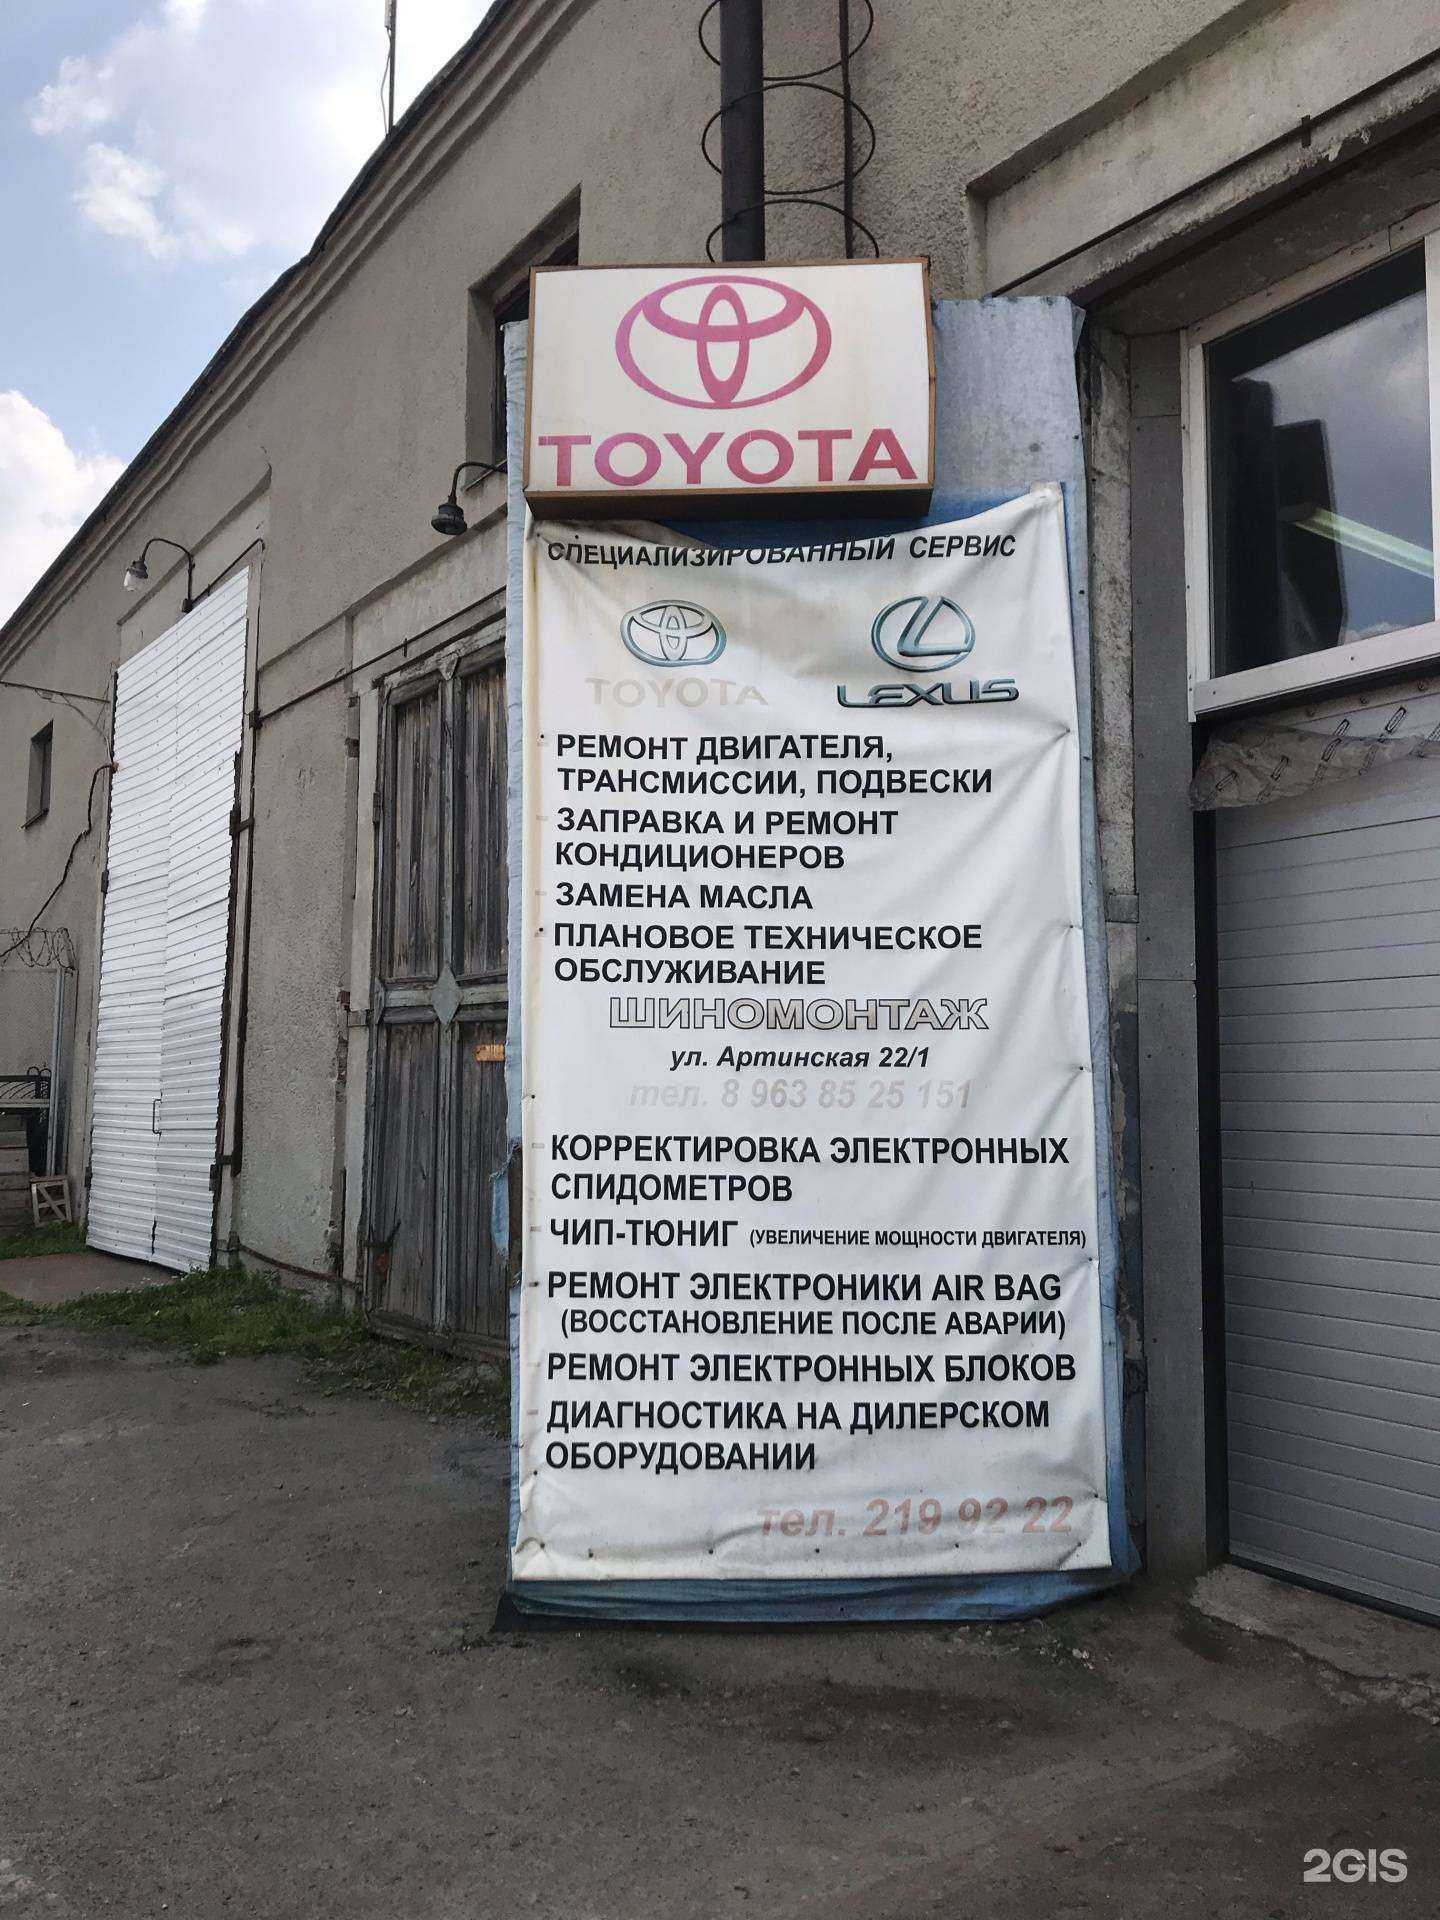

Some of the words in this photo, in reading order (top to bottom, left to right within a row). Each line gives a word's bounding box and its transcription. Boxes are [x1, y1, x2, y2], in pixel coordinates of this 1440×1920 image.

[538, 429, 917, 487] TOYOTA
[909, 534, 1017, 559] СЕРВИС
[585, 677, 769, 708] TOYOTA
[837, 678, 1020, 708] LEXUS
[558, 734, 688, 760] РЕМОНТ
[697, 735, 892, 765] ДВИГАТЕЛЯ,
[557, 768, 806, 798] ТРАНСМИССИИ,
[818, 769, 991, 798] ПОДВЕСКИ
[558, 808, 724, 833] ЗАПРАВКА
[735, 812, 753, 834] И
[766, 811, 898, 834] РЕМОНТ
[557, 842, 844, 872] КОНДИЦИОНЕРОВ
[556, 882, 690, 908] ЗАМЕНА
[700, 885, 813, 909] МАСЛА
[555, 923, 734, 949] ПЛАНОВОЕ
[744, 925, 981, 950] ТЕХНИЧЕСКОЕ
[555, 958, 825, 984] ОБСЛУЖИВАНИЕ
[610, 997, 989, 1030] ШИНОМОНТАЖ
[670, 1051, 707, 1071] ул.
[717, 1046, 869, 1071] Артинская
[879, 1047, 928, 1067] 22/1
[721, 1078, 740, 1109] 8
[751, 1078, 807, 1108] 963
[817, 1079, 857, 1108] 85
[867, 1079, 905, 1108] 25
[916, 1080, 972, 1109] 151
[552, 1135, 820, 1162] КОРРЕКТИРОВКА
[830, 1137, 1069, 1164] ЭЛЕКТРОННЫХ
[552, 1173, 792, 1205] СПИДОМЕТРОВ
[551, 1219, 738, 1246] ЧИП-ТЮНИГ
[750, 1229, 869, 1248] (УВЕЛИЧЕНИЕ
[876, 1231, 976, 1248] МОЩНОСТИ
[982, 1231, 1086, 1249] ДВИГАТЕЛЯ)
[549, 1272, 680, 1298] РЕМОНТ
[690, 1273, 921, 1300] ЭЛЕКТРОНИКИ
[932, 1275, 985, 1301] AIR
[995, 1274, 1060, 1300] BAG
[562, 1309, 833, 1338] (ВОССТАНОВЛЕНИЕ
[843, 1311, 936, 1335] ПОСЛЕ
[945, 1311, 1065, 1340] АВАРИИ)
[548, 1353, 679, 1380] РЕМОНТ
[690, 1354, 935, 1382] ЭЛЕКТРОННЫХ
[945, 1354, 1075, 1382] БЛОКОВ
[547, 1401, 787, 1433] ДИАГНОСТИКА
[797, 1402, 840, 1430] НА
[850, 1401, 1049, 1435] ДИЛЕРСКОМ
[546, 1442, 815, 1475] ОБОРУДОВАНИИ
[757, 1505, 846, 1537] тел.
[863, 1498, 942, 1536] 219
[958, 1497, 1008, 1533] 92
[1022, 1496, 1074, 1534] 22
